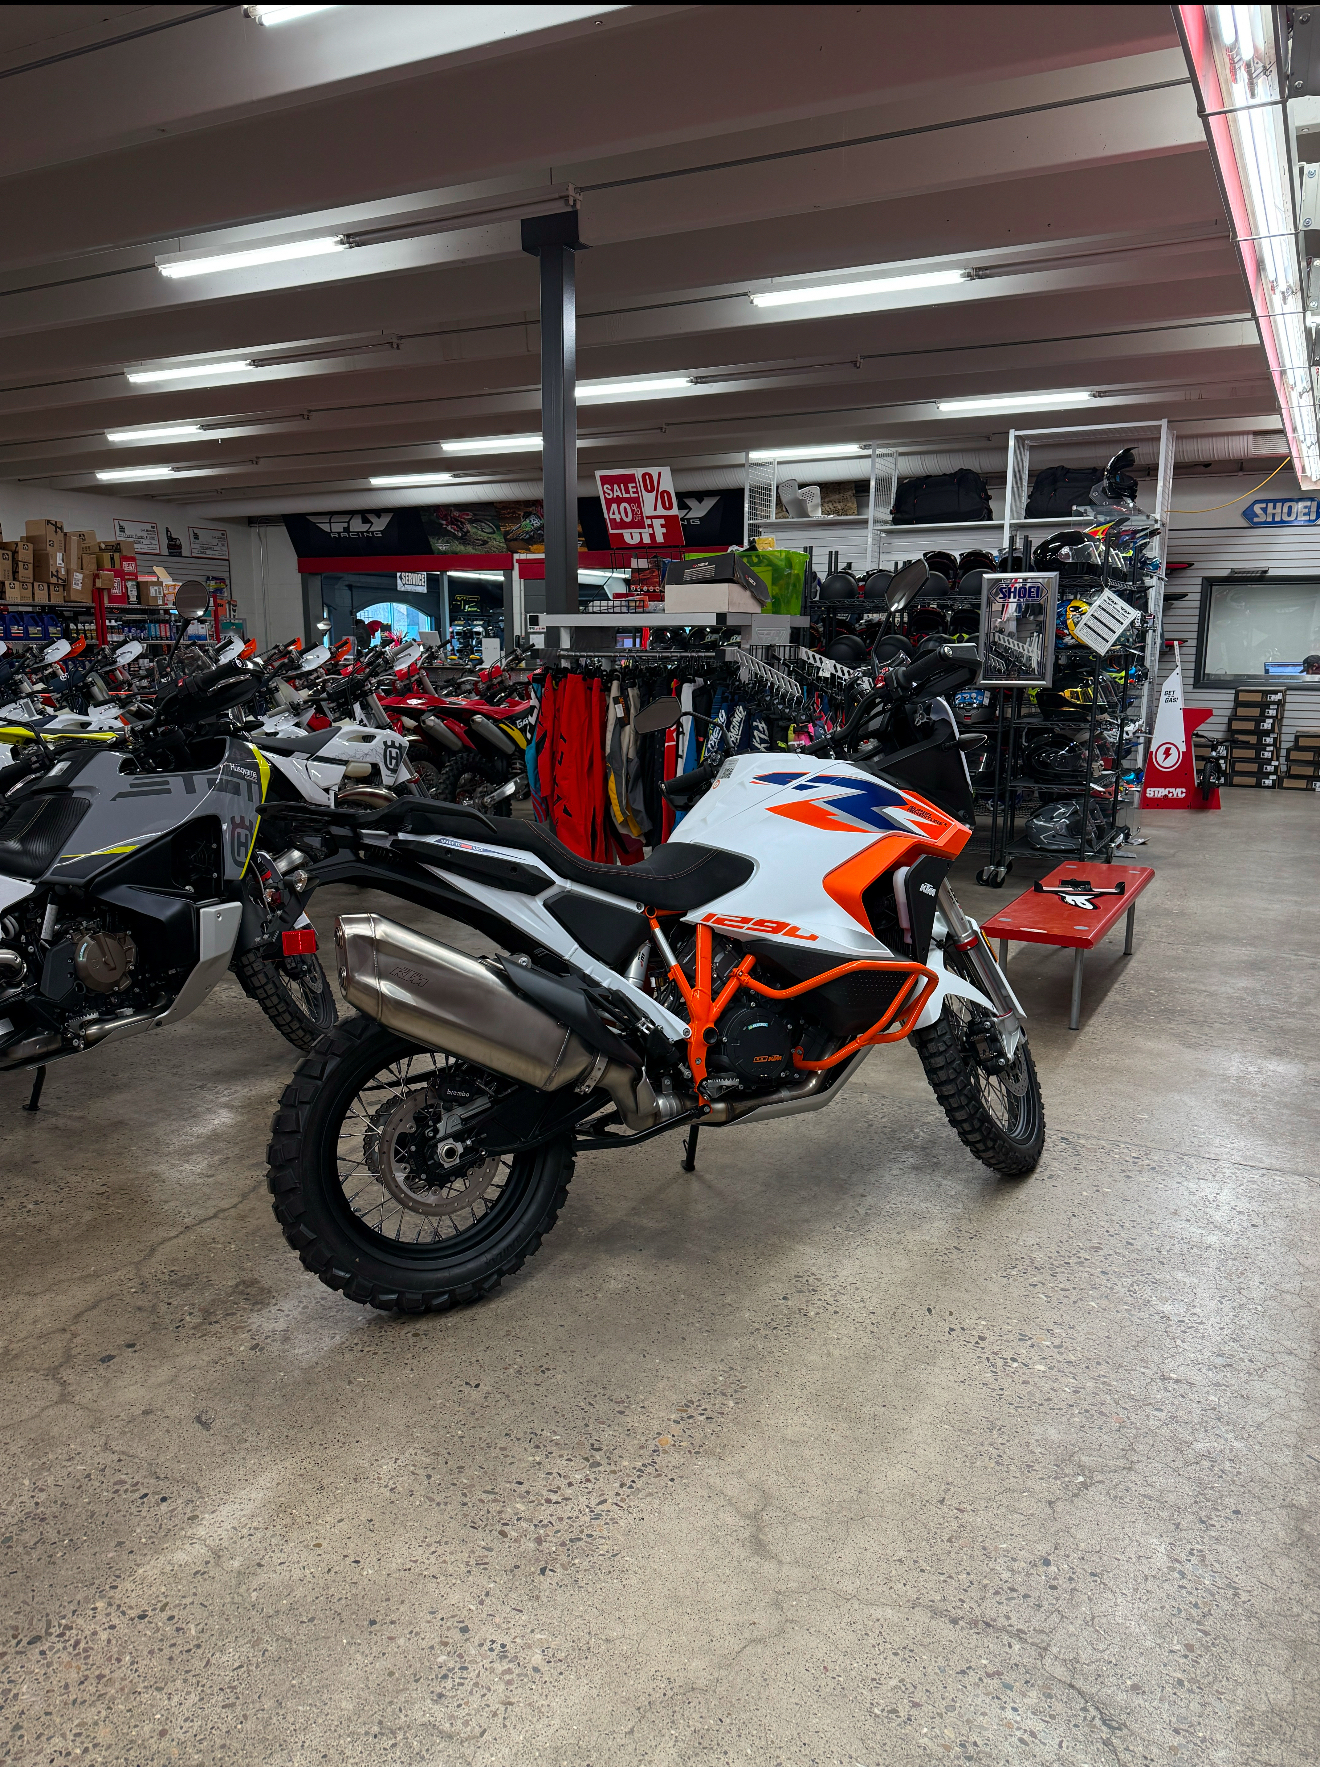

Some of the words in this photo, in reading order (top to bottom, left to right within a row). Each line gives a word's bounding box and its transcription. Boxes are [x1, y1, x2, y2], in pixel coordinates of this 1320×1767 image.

[604, 483, 638, 498] SALE
[1253, 501, 1317, 522] SHOEI
[305, 512, 394, 533] FLY
[400, 572, 425, 586] SERVICE
[998, 585, 1040, 600] SHOEI
[1146, 787, 1186, 798] STACYC
[919, 882, 936, 897] KTM
[446, 1088, 470, 1098] brembo
